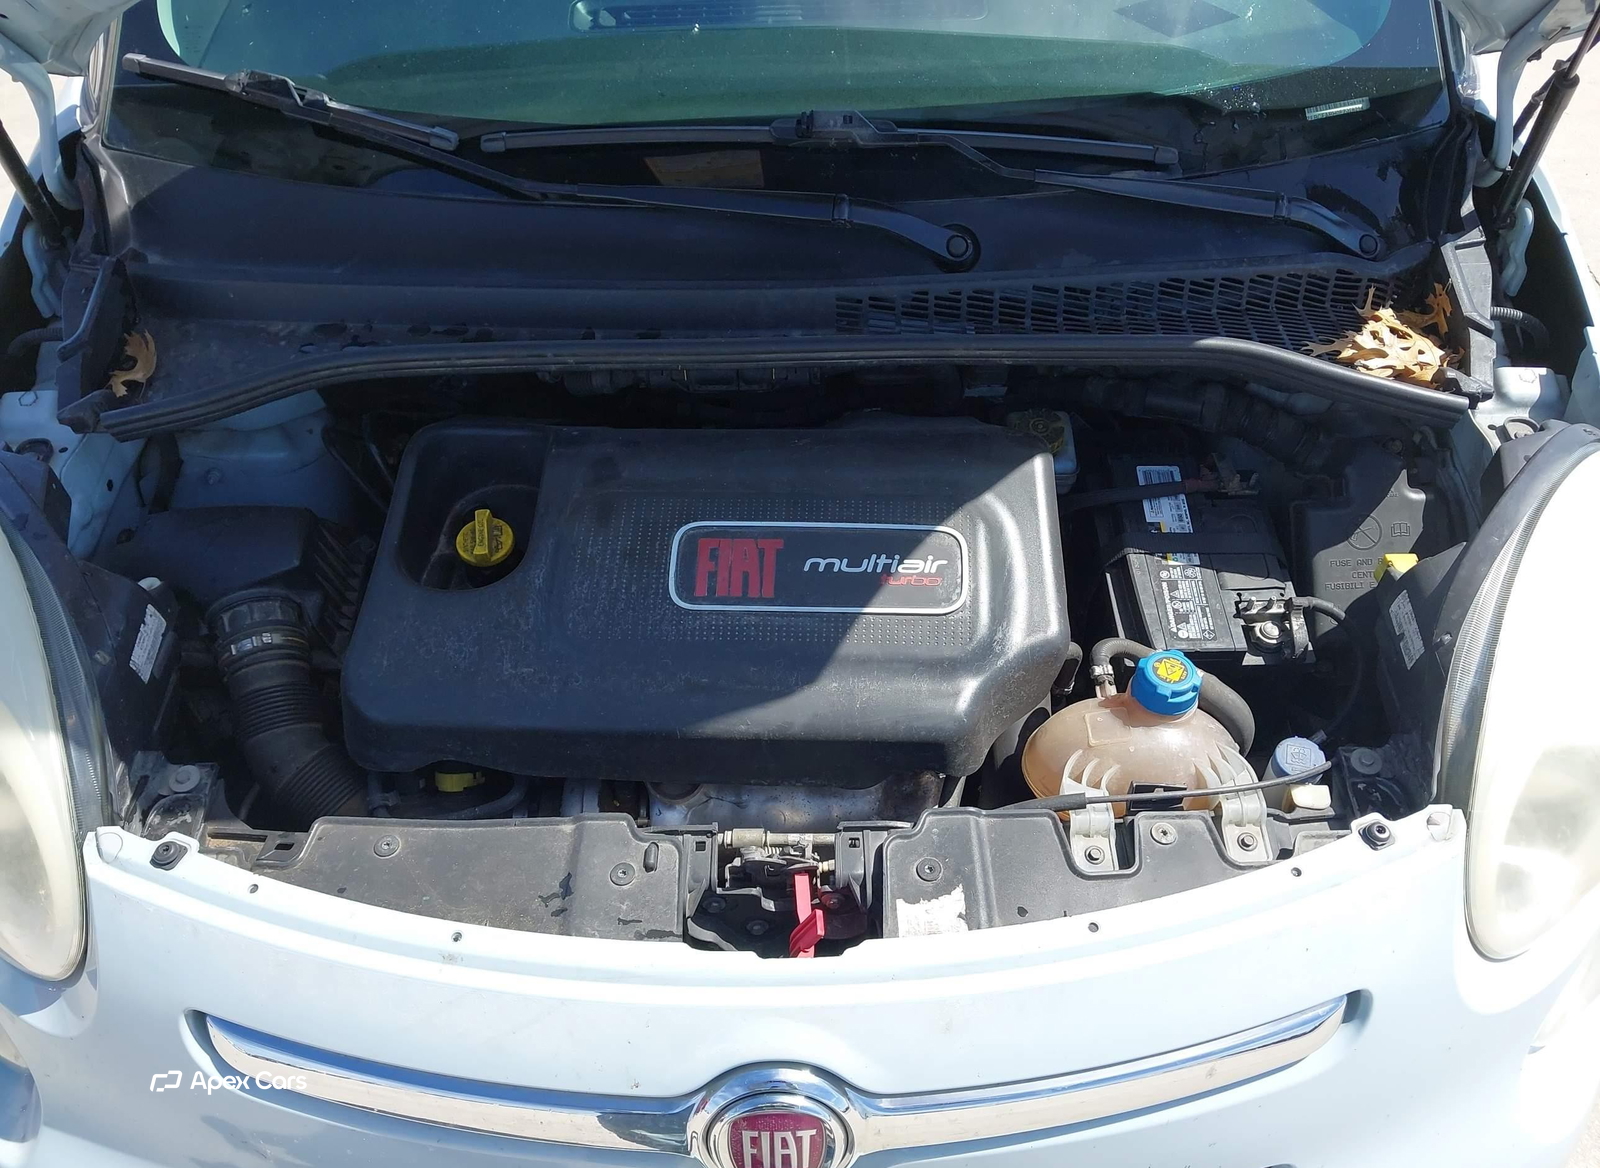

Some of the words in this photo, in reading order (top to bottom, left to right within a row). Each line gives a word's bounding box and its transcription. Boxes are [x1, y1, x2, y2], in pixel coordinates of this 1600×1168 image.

[694, 538, 784, 598] FIAT
[803, 553, 948, 574] multiair
[1329, 559, 1352, 568] FUSE
[1356, 558, 1373, 566] AND
[879, 575, 943, 587] turbo
[1351, 571, 1374, 579] CENT
[1324, 582, 1365, 590] FUSIBILI
[741, 1129, 817, 1168] FIAT
